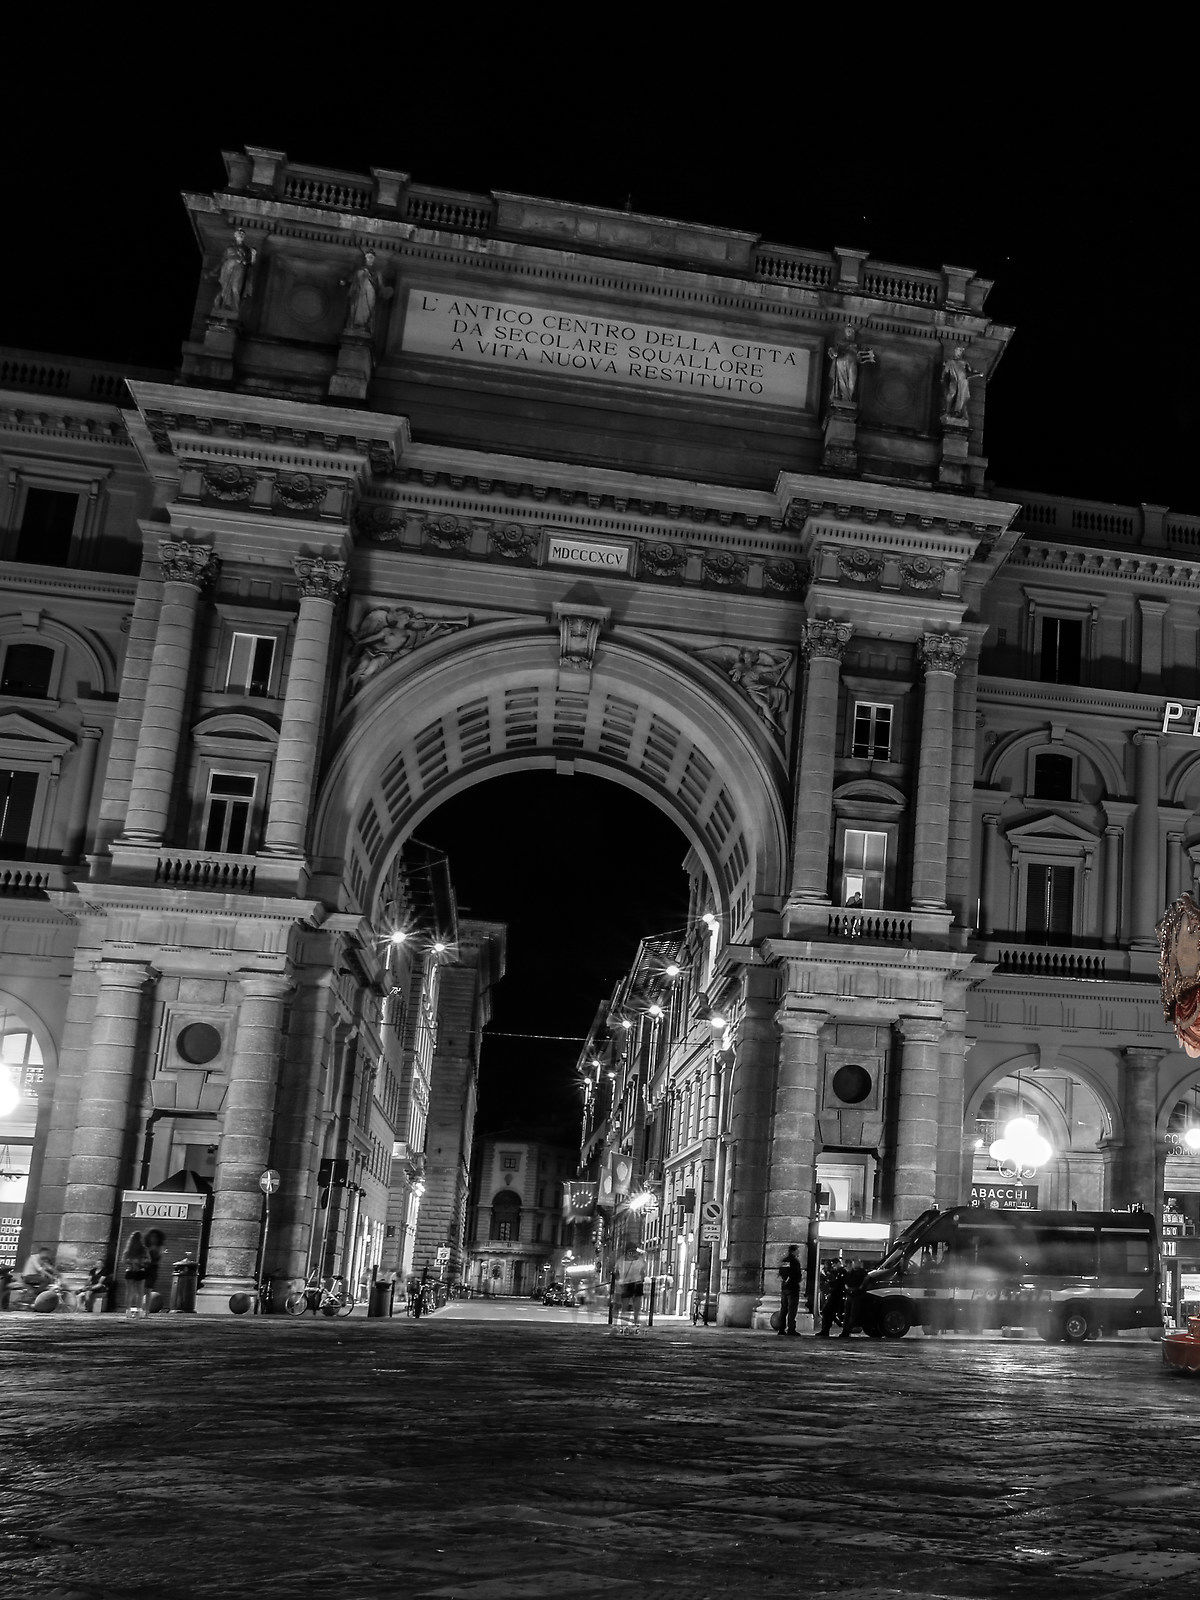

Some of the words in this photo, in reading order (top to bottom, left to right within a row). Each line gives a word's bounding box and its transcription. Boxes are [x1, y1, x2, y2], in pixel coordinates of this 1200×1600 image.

[448, 301, 533, 325] ANTICO
[543, 315, 636, 341] CENTRO
[646, 330, 721, 355] DELLA
[453, 319, 483, 337] DA
[494, 325, 618, 356] SECOLARE
[628, 345, 765, 378] SQUALLORE
[451, 338, 464, 352] A
[477, 340, 529, 361] VITA
[540, 349, 617, 374] NUOVA
[628, 362, 764, 395] RESTITUITO
[552, 546, 624, 565] MDCCCXCV
[138, 1204, 188, 1218] VOGUE
